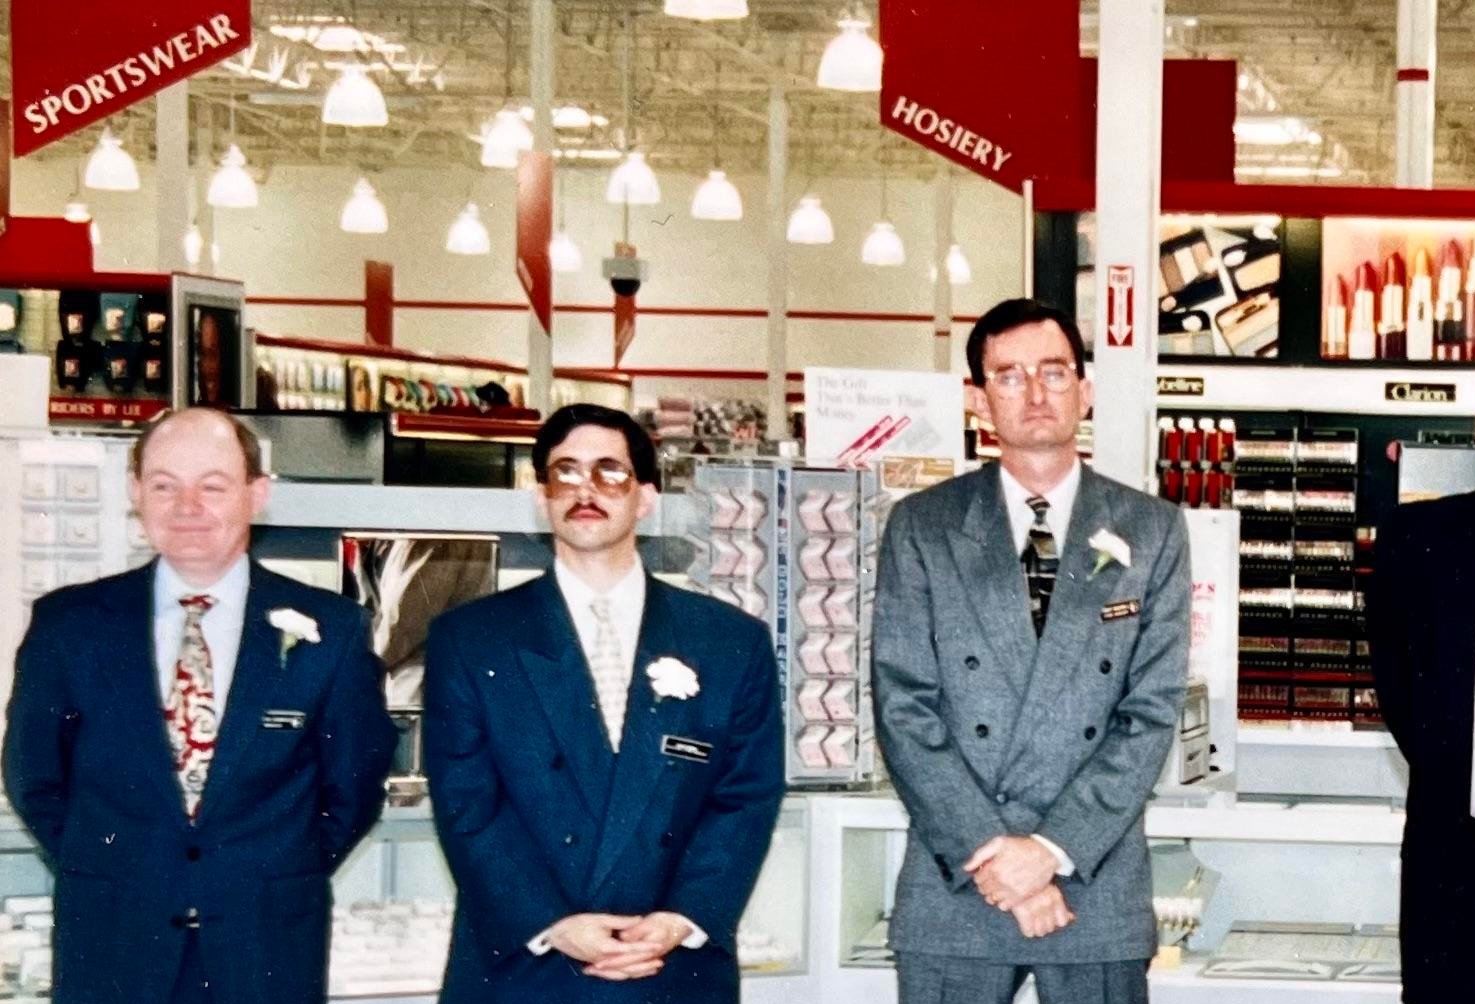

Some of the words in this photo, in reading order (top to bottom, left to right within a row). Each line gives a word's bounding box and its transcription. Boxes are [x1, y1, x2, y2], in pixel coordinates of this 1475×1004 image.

[24, 13, 240, 134] SPORTSWEAR
[892, 95, 1012, 172] HOSIERY
[1391, 383, 1449, 402] Clarion
